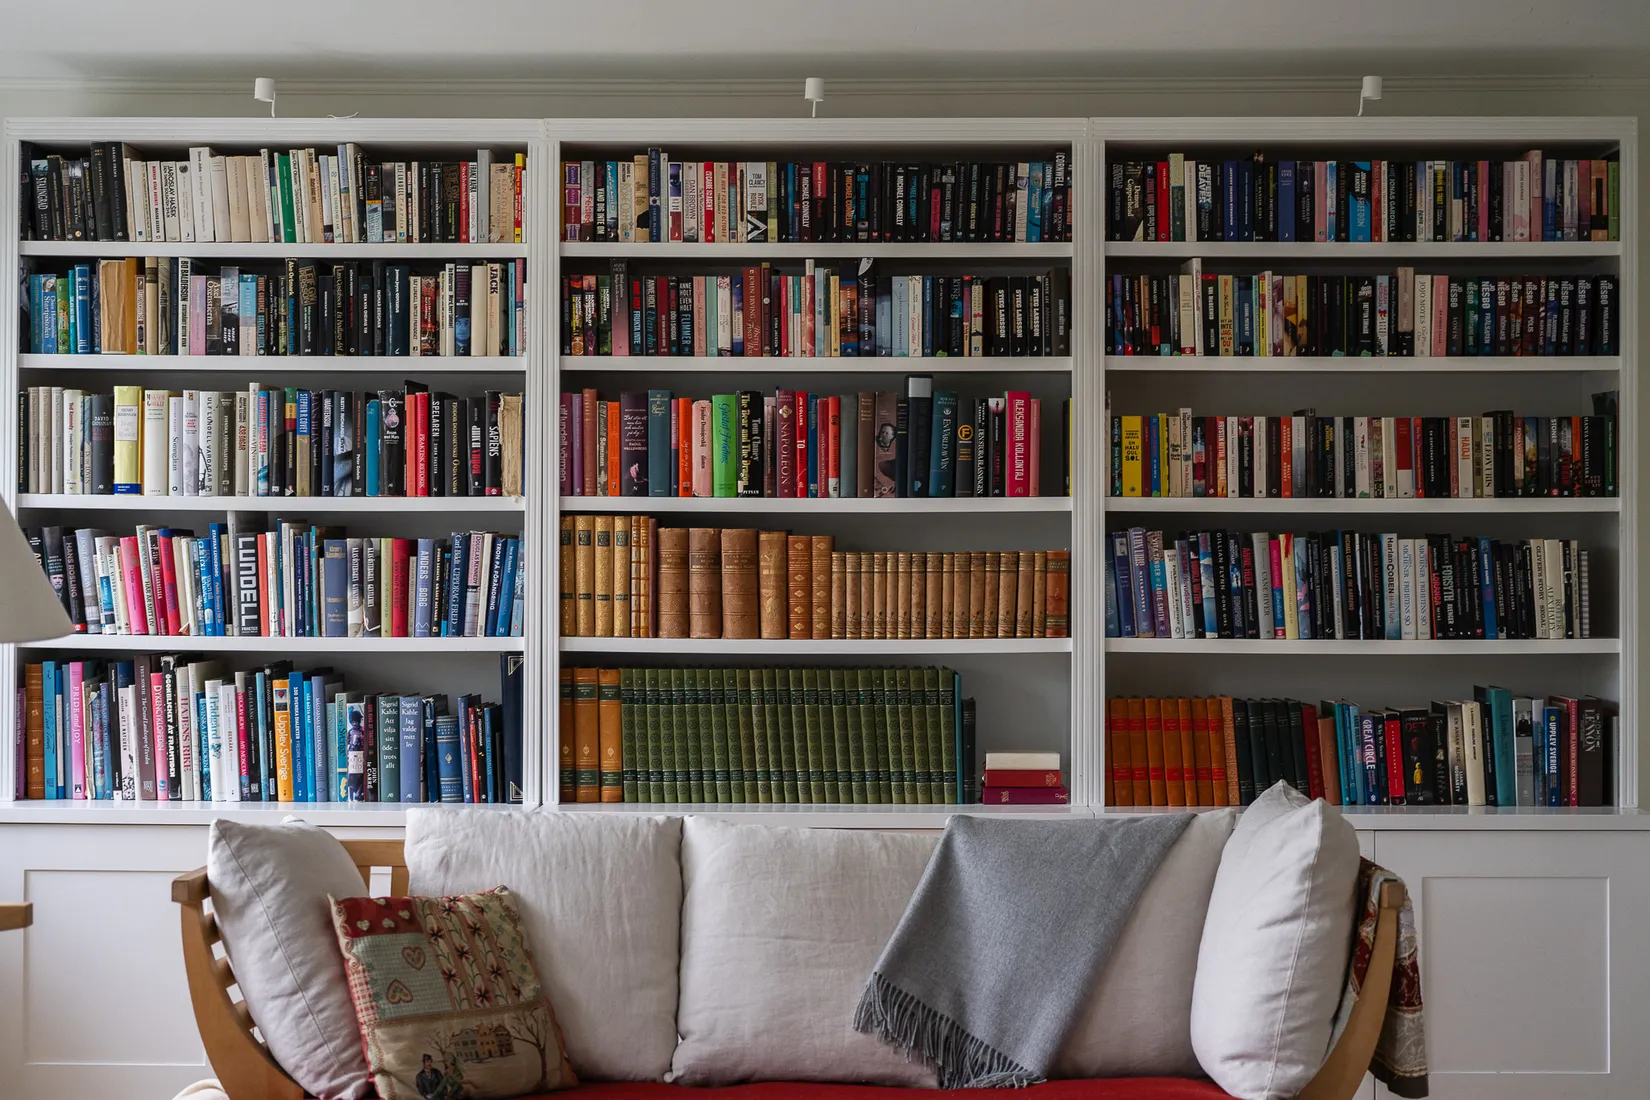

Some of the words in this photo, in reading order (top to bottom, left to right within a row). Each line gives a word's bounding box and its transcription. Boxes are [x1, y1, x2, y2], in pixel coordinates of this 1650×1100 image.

[167, 165, 175, 195] JAROSLAV
[1055, 155, 1065, 187] CORNWELL
[36, 177, 47, 210] STALINGRAD
[396, 175, 404, 196] LUNDELL
[169, 197, 177, 218] HAŠEK
[180, 269, 188, 301] BALDERSON
[489, 267, 498, 294] JACK
[646, 279, 655, 294] ANNE
[1561, 281, 1569, 305] NESBØ
[1578, 280, 1586, 304] NESBØ
[1600, 280, 1608, 304] NESBØ
[647, 295, 655, 308] HOLT
[1450, 283, 1458, 308] NESBØ
[1481, 281, 1490, 308] NESBØ
[43, 295, 51, 338] Startpistolen
[682, 314, 690, 345] FLIMMER
[742, 394, 750, 408] The
[432, 401, 440, 437] SPELAREN
[719, 403, 731, 430] Gustaf
[742, 410, 750, 426] Bear
[752, 418, 760, 434] Tom
[1014, 400, 1025, 441] ALEKSANDRA
[488, 426, 499, 456] SAPIENS
[719, 430, 731, 464] Fröding
[742, 429, 750, 441] and
[977, 429, 985, 440] DEN
[171, 437, 179, 471] Sömngåtan
[742, 444, 750, 458] The
[750, 436, 761, 461] Clancy
[781, 422, 791, 485] NAPOLEON
[977, 441, 985, 458] STORA
[1015, 443, 1025, 480] KOLLONTAJ
[1461, 437, 1470, 460] HADJI
[1484, 444, 1492, 464] LEON
[740, 459, 750, 485] Dragon
[977, 459, 986, 494] BLÅSNINGEN
[66, 543, 75, 565] HANS
[453, 535, 462, 549] Carl
[420, 551, 429, 579] ANDERS
[453, 551, 461, 564] Bildt
[492, 560, 502, 571] PÅ
[1535, 546, 1544, 576] OLIVER'S
[68, 565, 77, 597] ROSLING
[238, 536, 258, 627] LUNDELL
[452, 567, 461, 602] UPPDRAG
[472, 560, 480, 584] KENNEDY
[1218, 565, 1226, 590] FLYNN
[1261, 571, 1269, 591] CANE
[1387, 564, 1395, 594] COBEN
[1442, 565, 1454, 601] FORSYTH
[419, 587, 428, 607] BORG
[489, 571, 501, 610] FÖRÄNDRING
[1155, 583, 1163, 601] ZADIE
[1432, 573, 1441, 606] LORANGA
[451, 604, 459, 624] FRED
[1157, 603, 1165, 621] SMITH
[1262, 592, 1270, 616] RIVER
[1547, 607, 1555, 632] HALEY
[165, 674, 175, 722] ÖGONBLICKET
[154, 685, 165, 751] DYKENCYKLOPEDIN
[167, 724, 176, 735] ÅT
[180, 697, 190, 742] HAJENS
[209, 693, 222, 740] Trädgård
[277, 715, 288, 747] Upplev
[1363, 719, 1373, 744] GREAT
[1548, 722, 1556, 746] UPPLEV
[1584, 709, 1596, 752] LENNON
[168, 736, 176, 777] FRAMTIDEN
[182, 744, 192, 772] RIKE
[279, 748, 289, 780] Sverige
[1365, 745, 1376, 770] CIRCLE
[1549, 747, 1557, 774] SVERIGE
